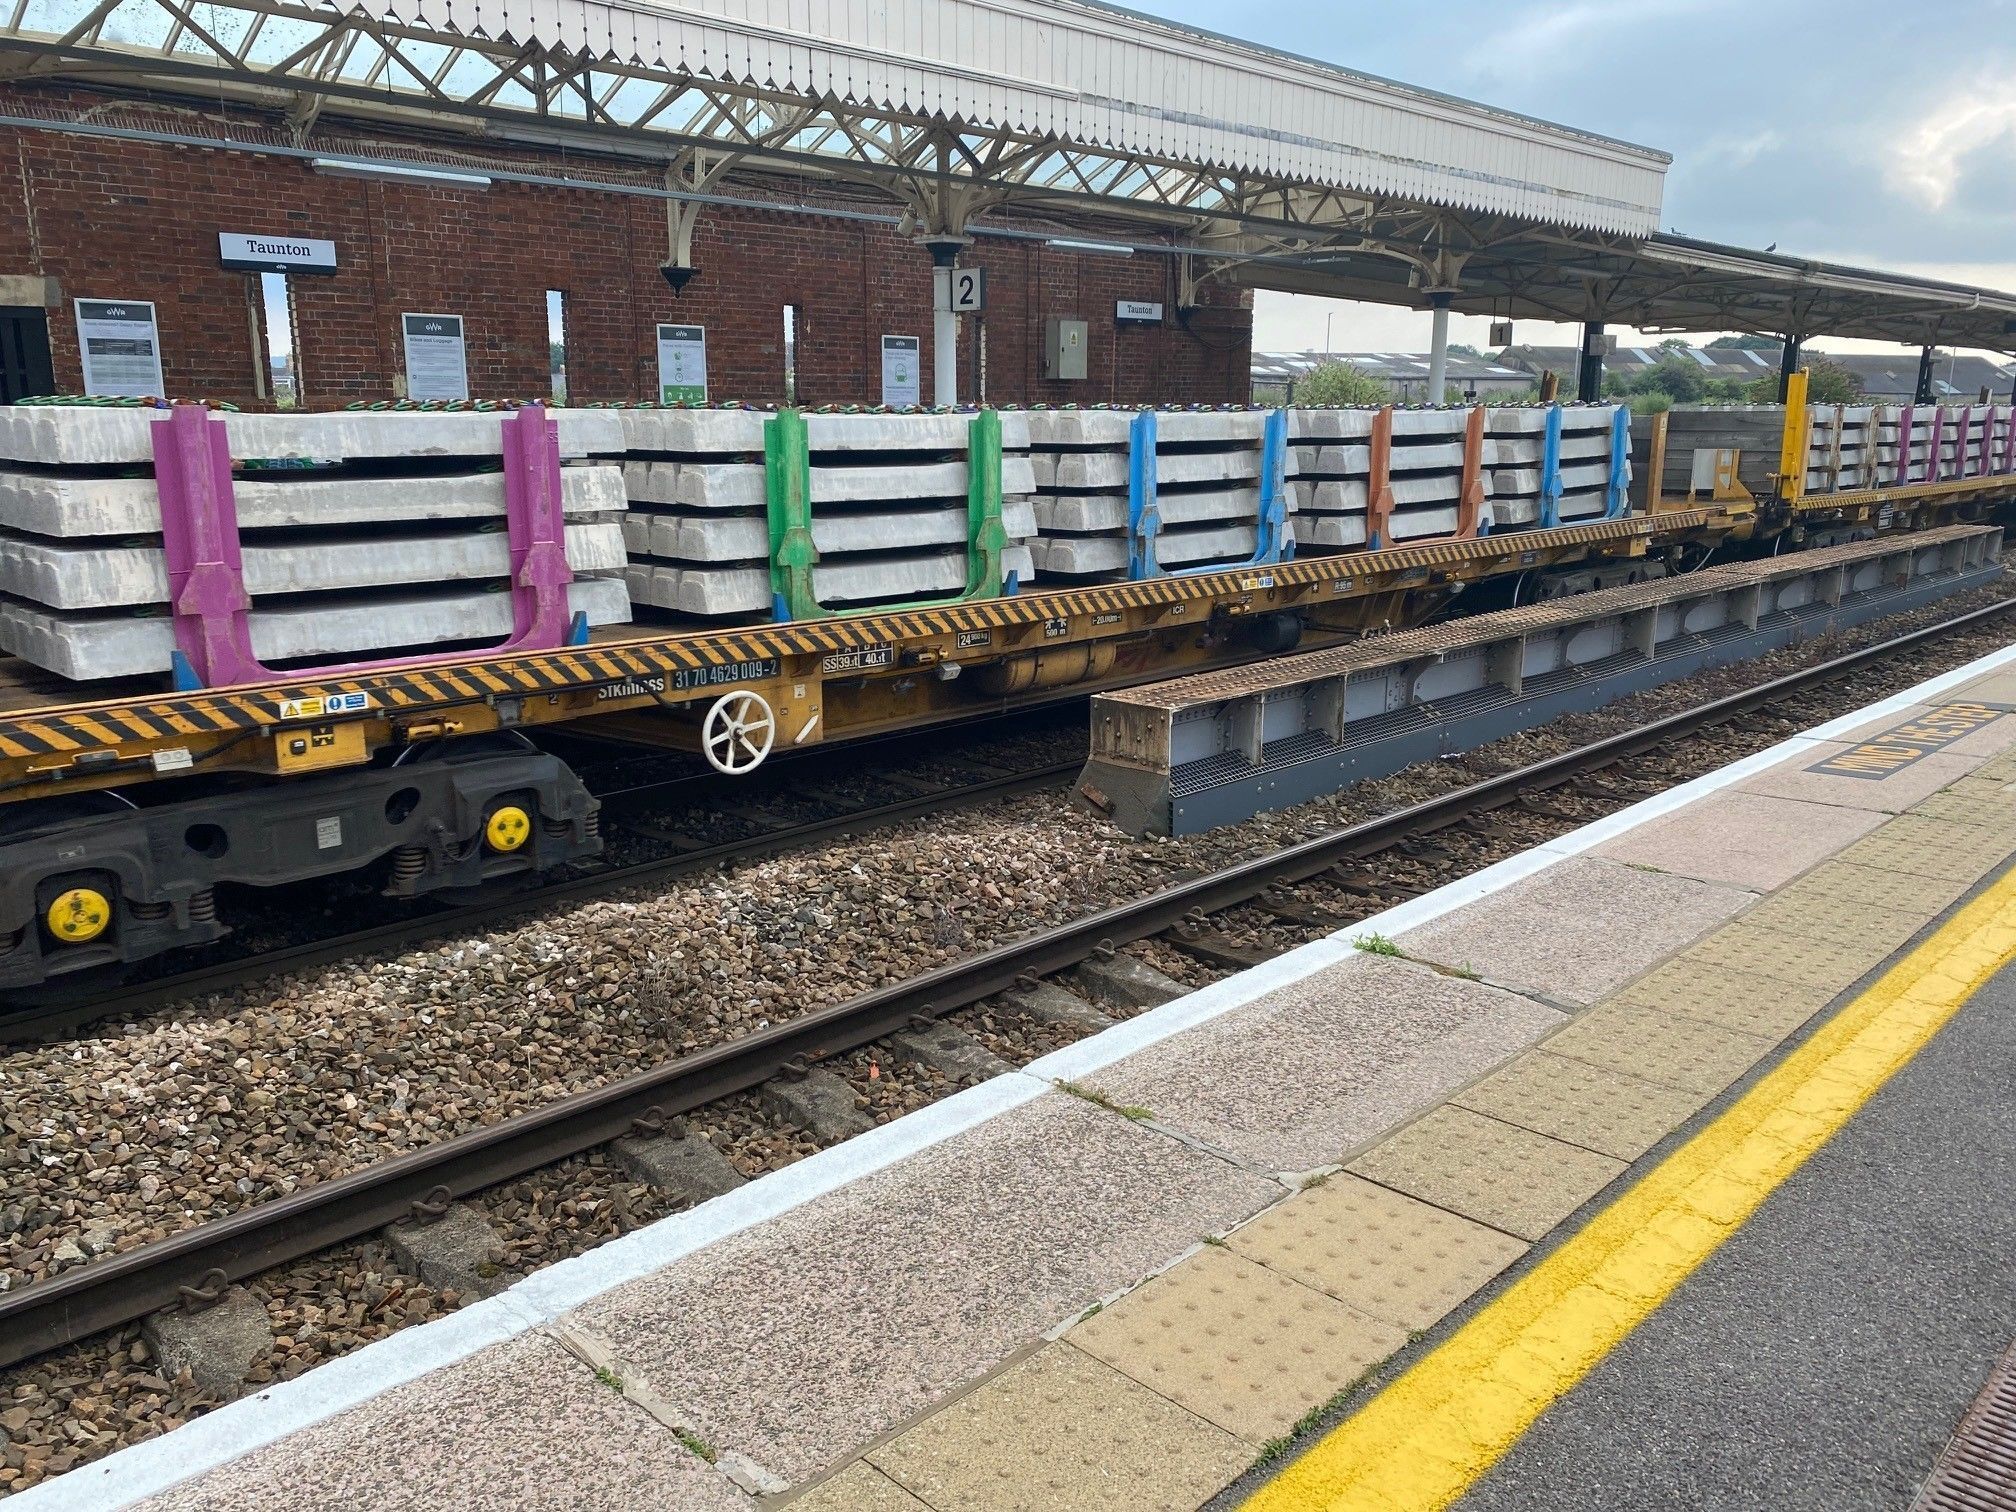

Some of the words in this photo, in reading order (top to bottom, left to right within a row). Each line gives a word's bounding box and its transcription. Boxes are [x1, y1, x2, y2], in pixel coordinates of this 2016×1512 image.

[247, 240, 311, 256] Taunton
[960, 275, 973, 304] 2
[1127, 305, 1152, 314] Taunton
[1498, 326, 1503, 342] 1
[960, 634, 971, 645] 24
[1046, 628, 1057, 637] 500
[824, 658, 837, 670] SS
[676, 671, 690, 688] 31
[693, 669, 707, 685] 70
[710, 664, 739, 683] 4629
[1917, 703, 2002, 730] STEP
[1874, 726, 1964, 746] THE
[1820, 745, 1922, 774] MIND
